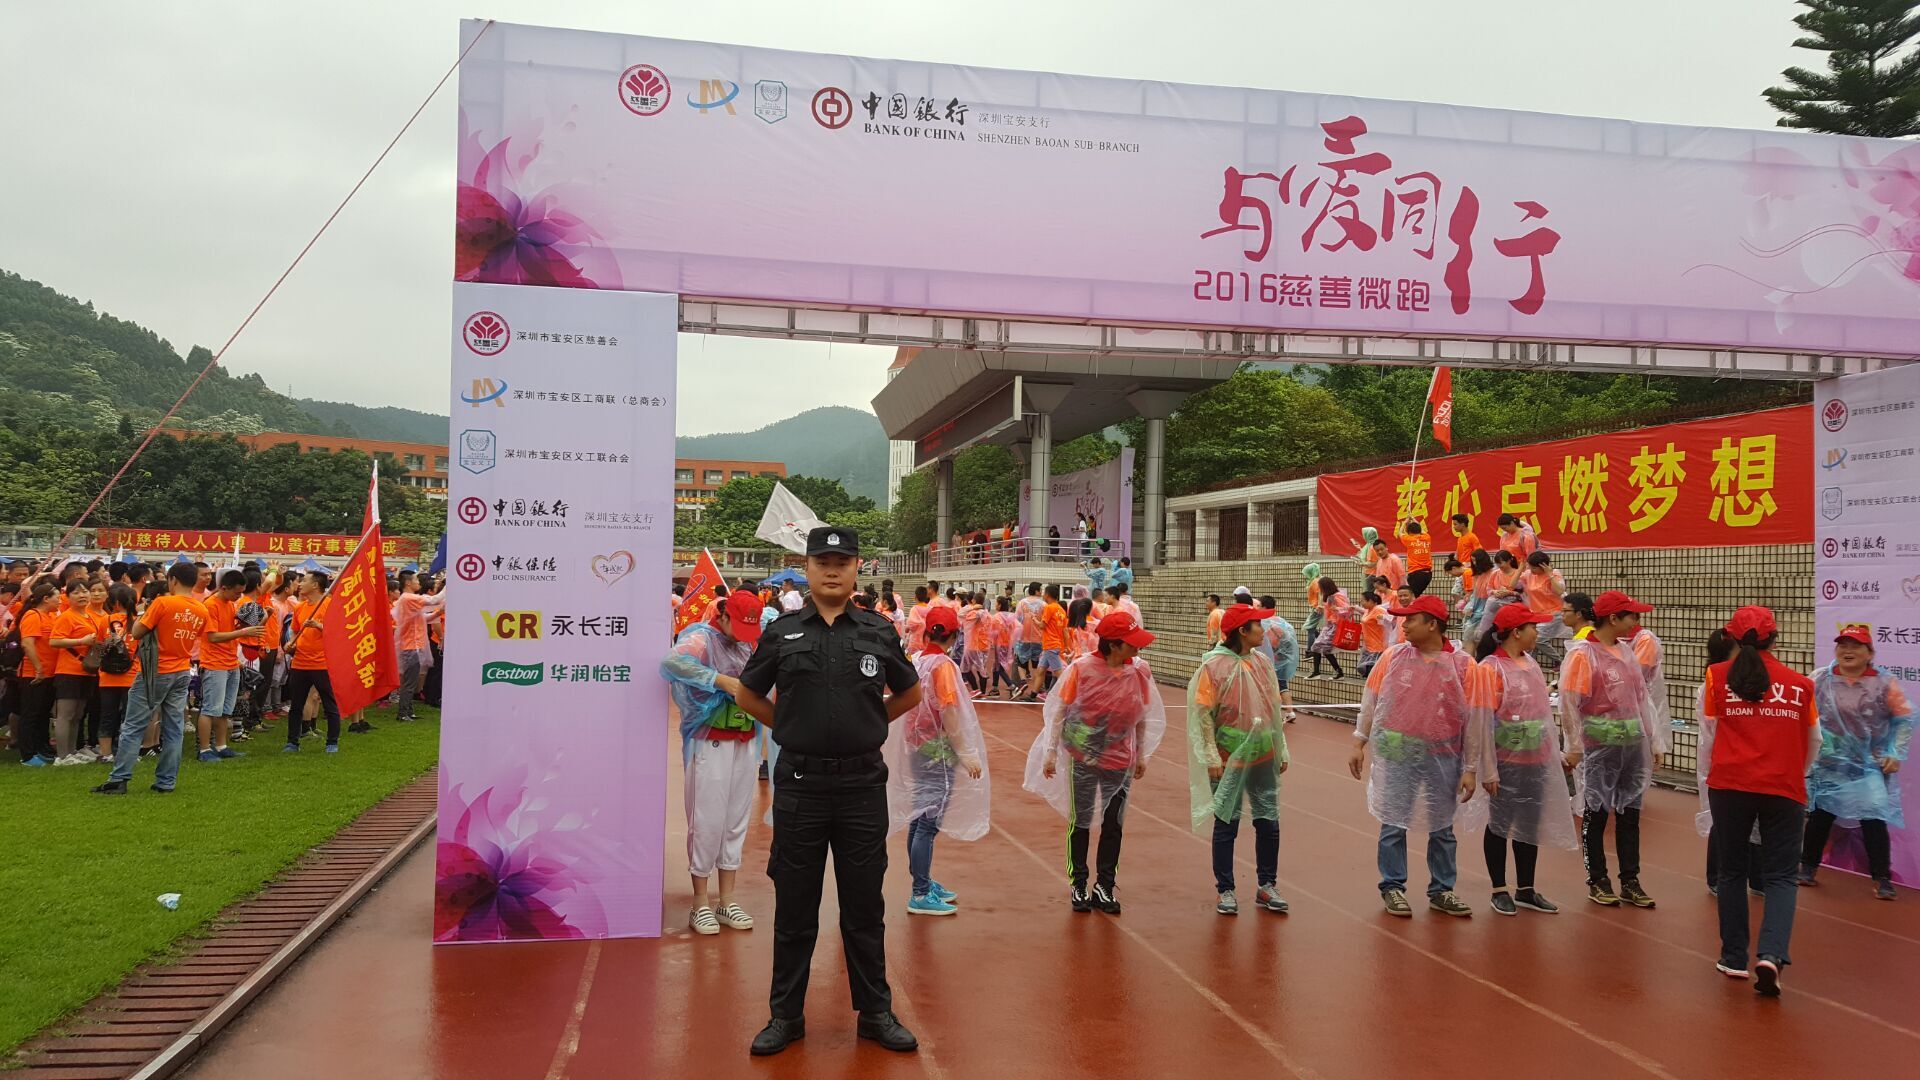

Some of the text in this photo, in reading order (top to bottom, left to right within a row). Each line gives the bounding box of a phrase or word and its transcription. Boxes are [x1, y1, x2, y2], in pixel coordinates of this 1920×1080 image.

[978, 112, 1051, 129] 深圳宝安支行
[864, 122, 965, 141] BANK OF CHINA
[977, 132, 1031, 145] SHENZHEN
[1035, 137, 1070, 149] BAOAN
[1200, 115, 1561, 315] 与爱同行
[1193, 268, 1431, 312] 2016慈善微跑
[516, 331, 619, 347] 深圳市宝安区慈善会
[513, 390, 668, 407] 深圳市宝安区工商联（总商会）
[504, 449, 630, 463] 深圳市宝安区义工联合会
[1393, 434, 1776, 539] 慈心点燃梦想
[495, 519, 520, 527] BANK
[537, 520, 566, 528] CHINA
[584, 512, 654, 524] 深圳宝安支行
[117, 533, 246, 550] 以慈待人人人尊
[269, 537, 397, 555] 以善行事事成
[480, 610, 541, 640] YCR
[551, 615, 628, 637] 永长润
[174, 628, 197, 640] 2016
[550, 664, 631, 682] 华润怡宝
[1726, 707, 1753, 716] BAOAN
